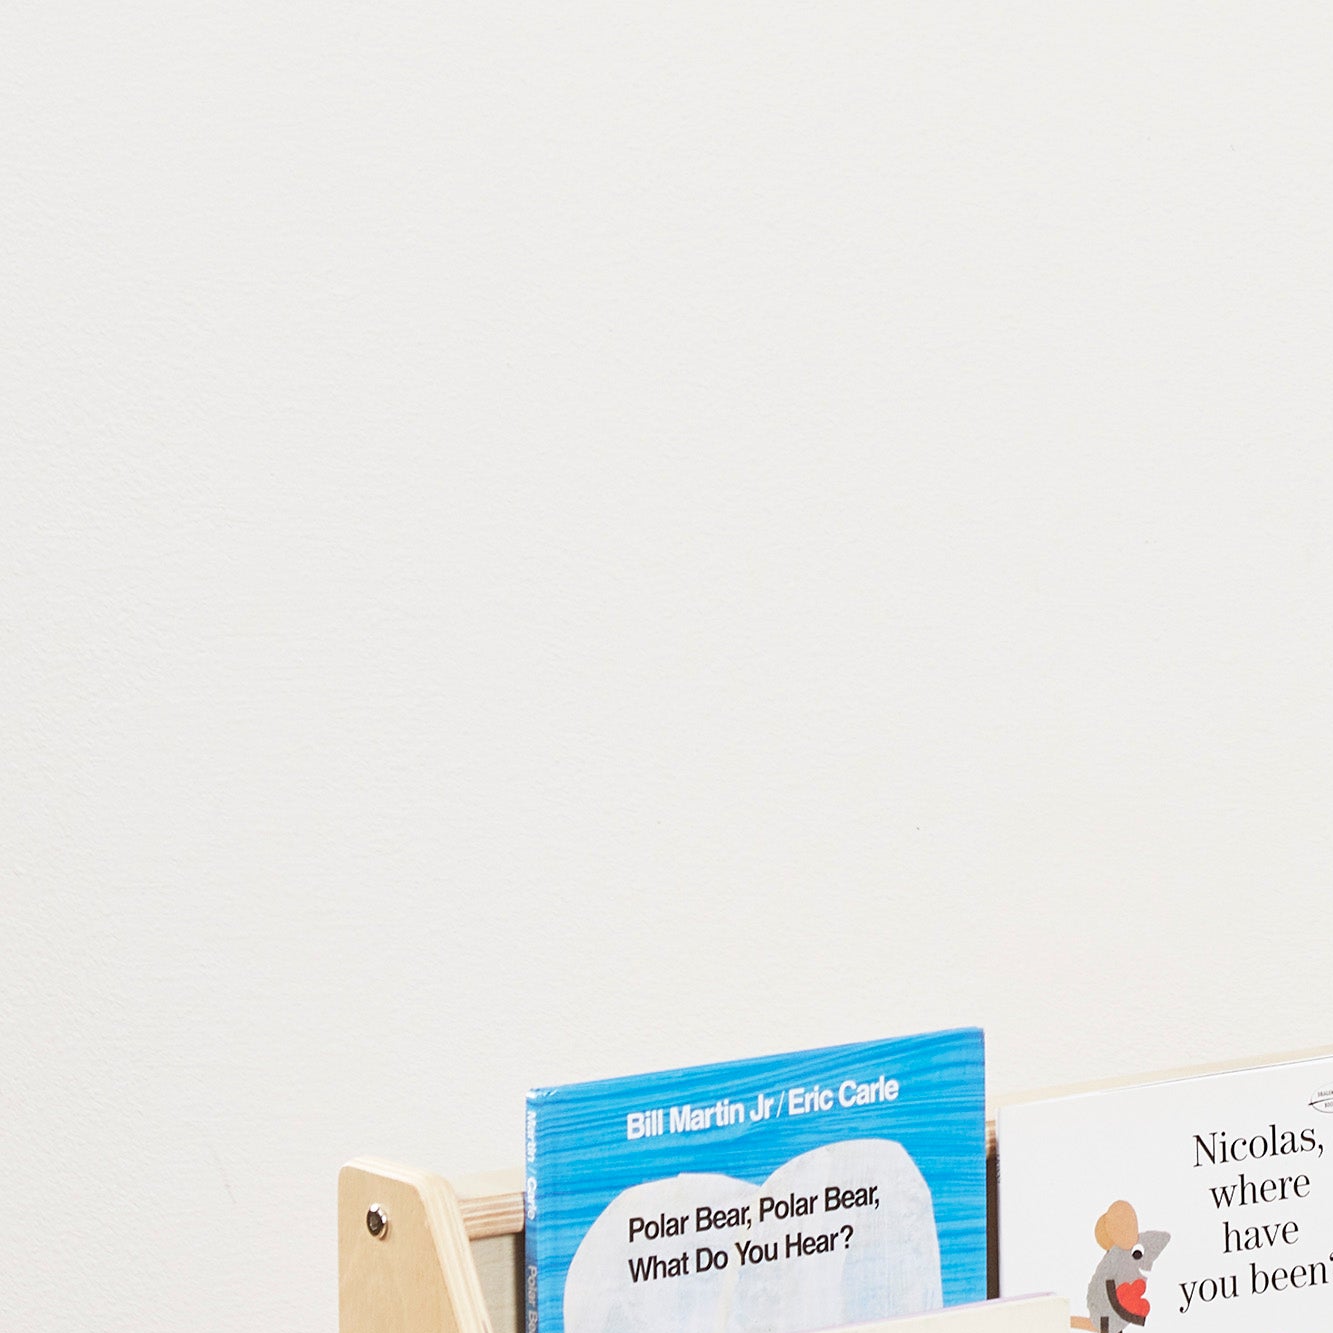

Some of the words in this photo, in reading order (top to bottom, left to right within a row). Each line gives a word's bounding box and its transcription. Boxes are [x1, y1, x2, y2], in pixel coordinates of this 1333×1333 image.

[626, 1110, 663, 1141] Bill
[670, 1099, 745, 1135] Martin
[749, 1094, 774, 1123] Jr
[788, 1083, 833, 1117] Eric
[838, 1076, 900, 1107] Carle
[1193, 1124, 1324, 1167] Nicolas,
[628, 1211, 689, 1243] Polar
[695, 1206, 753, 1233] Bear,
[759, 1193, 818, 1224] Polar
[824, 1183, 880, 1212] Bear,
[1210, 1174, 1311, 1209] where
[628, 1254, 689, 1284] What
[695, 1247, 729, 1273] Do
[735, 1240, 779, 1267] You
[785, 1225, 854, 1258] Hear?
[1222, 1221, 1299, 1254] have
[1179, 1271, 1239, 1313] you
